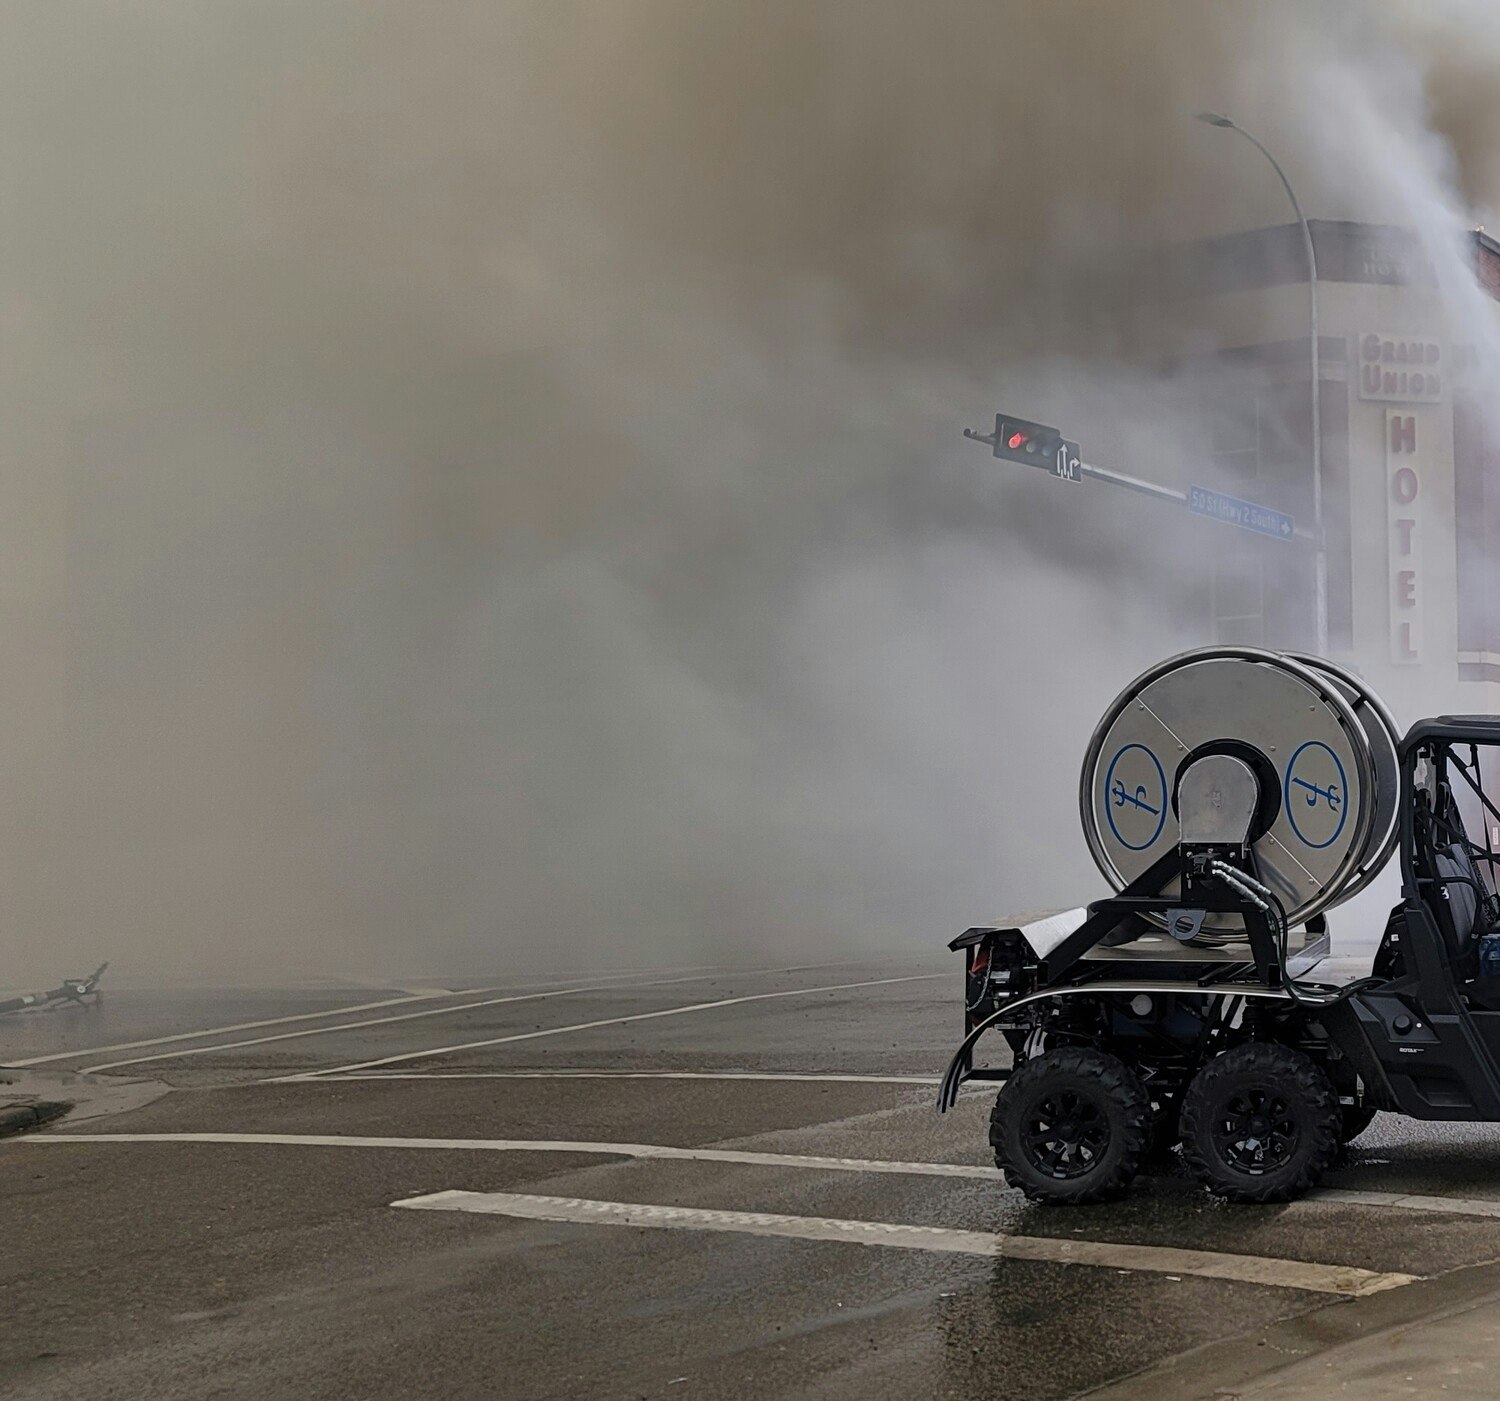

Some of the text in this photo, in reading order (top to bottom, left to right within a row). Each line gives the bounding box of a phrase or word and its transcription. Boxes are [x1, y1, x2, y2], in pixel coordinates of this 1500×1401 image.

[1362, 334, 1440, 363] GRAND
[1362, 365, 1441, 394] UNION
[1192, 491, 1206, 509] 50
[1207, 496, 1217, 514] St
[1244, 506, 1250, 522] 2
[1392, 416, 1418, 659] HOTEL
